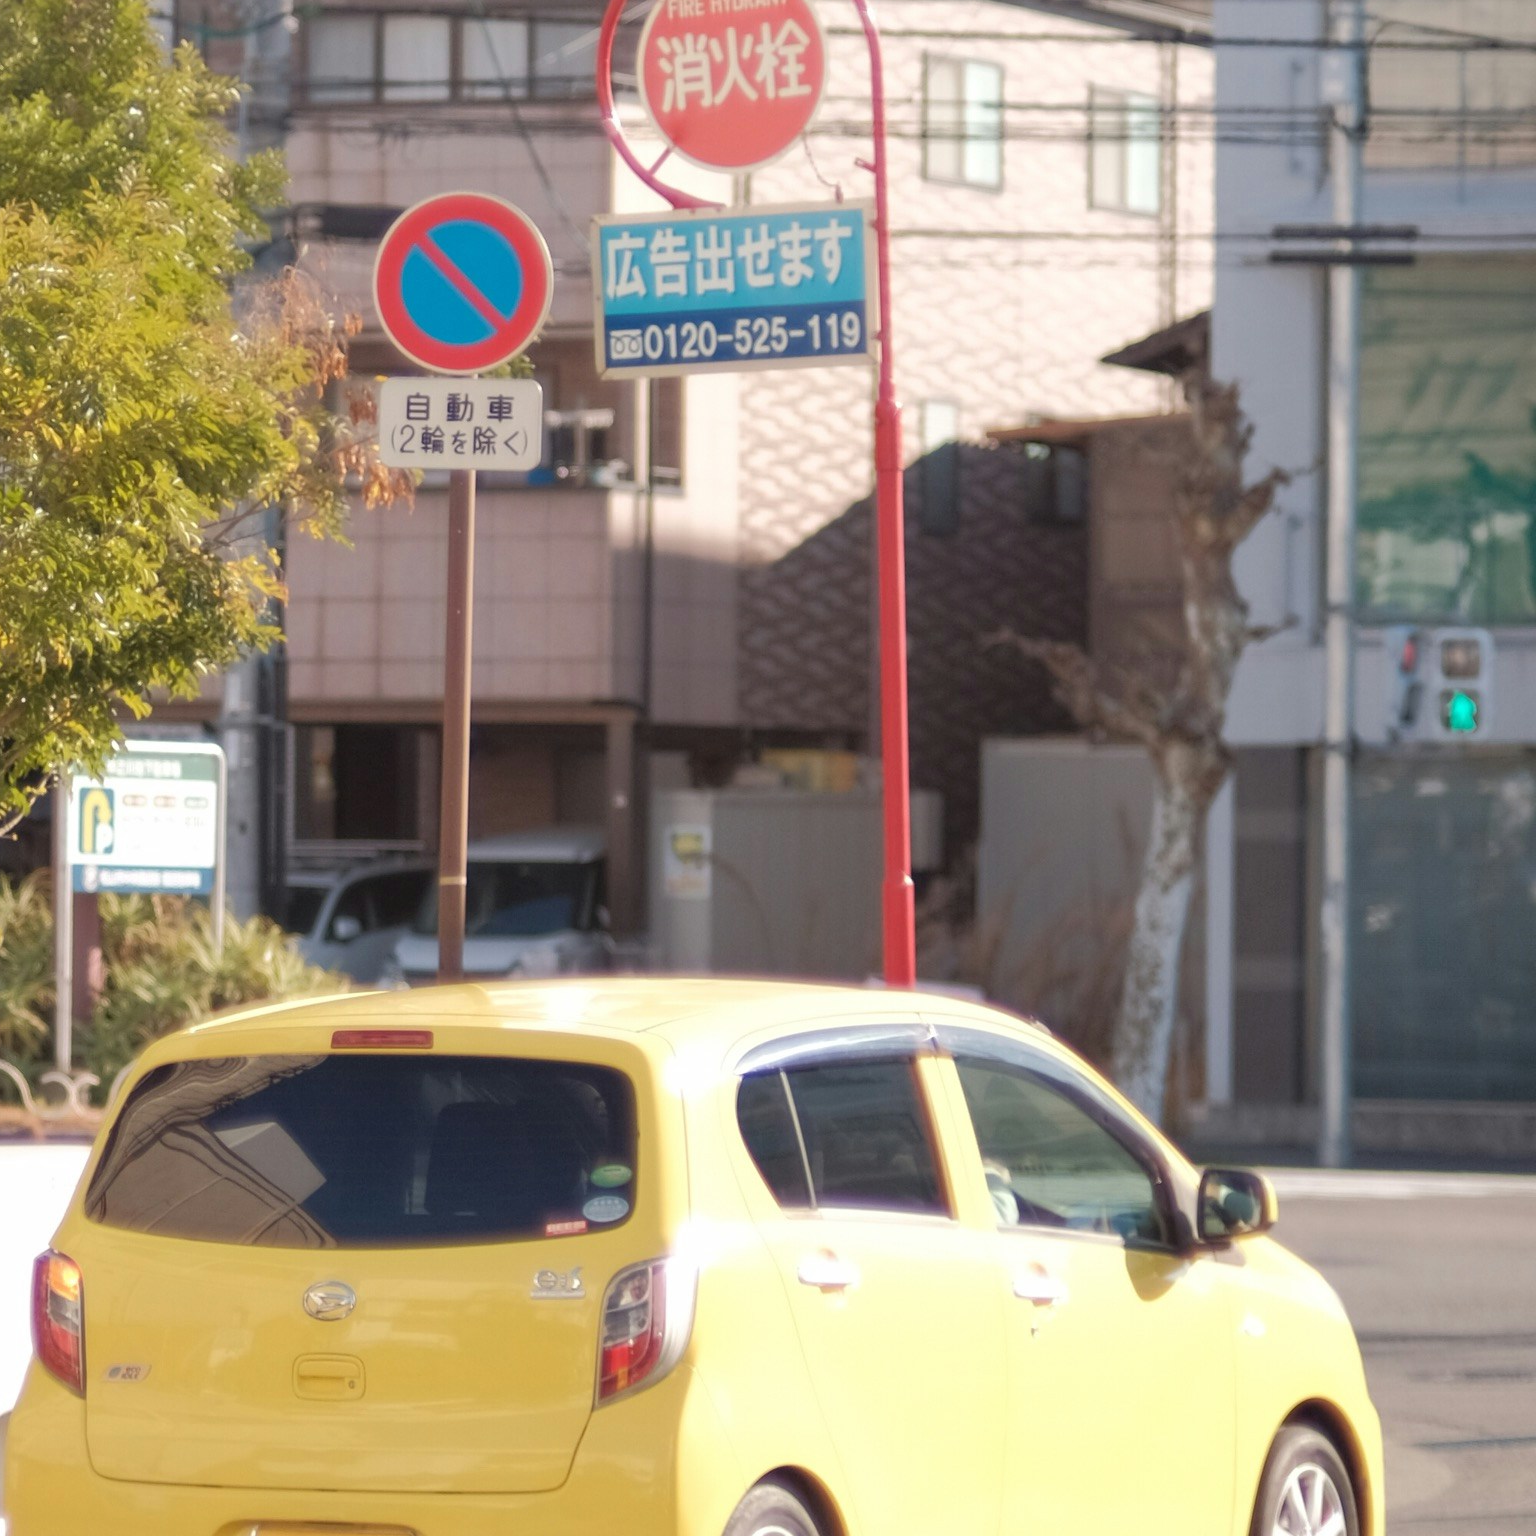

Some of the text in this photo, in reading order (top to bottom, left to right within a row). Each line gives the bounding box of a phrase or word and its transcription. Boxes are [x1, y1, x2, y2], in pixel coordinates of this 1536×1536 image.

[656, 18, 813, 113] 消火栓
[606, 218, 853, 298] 広告出せます
[644, 311, 861, 360] 0120-525-119
[406, 392, 514, 423] 自動車
